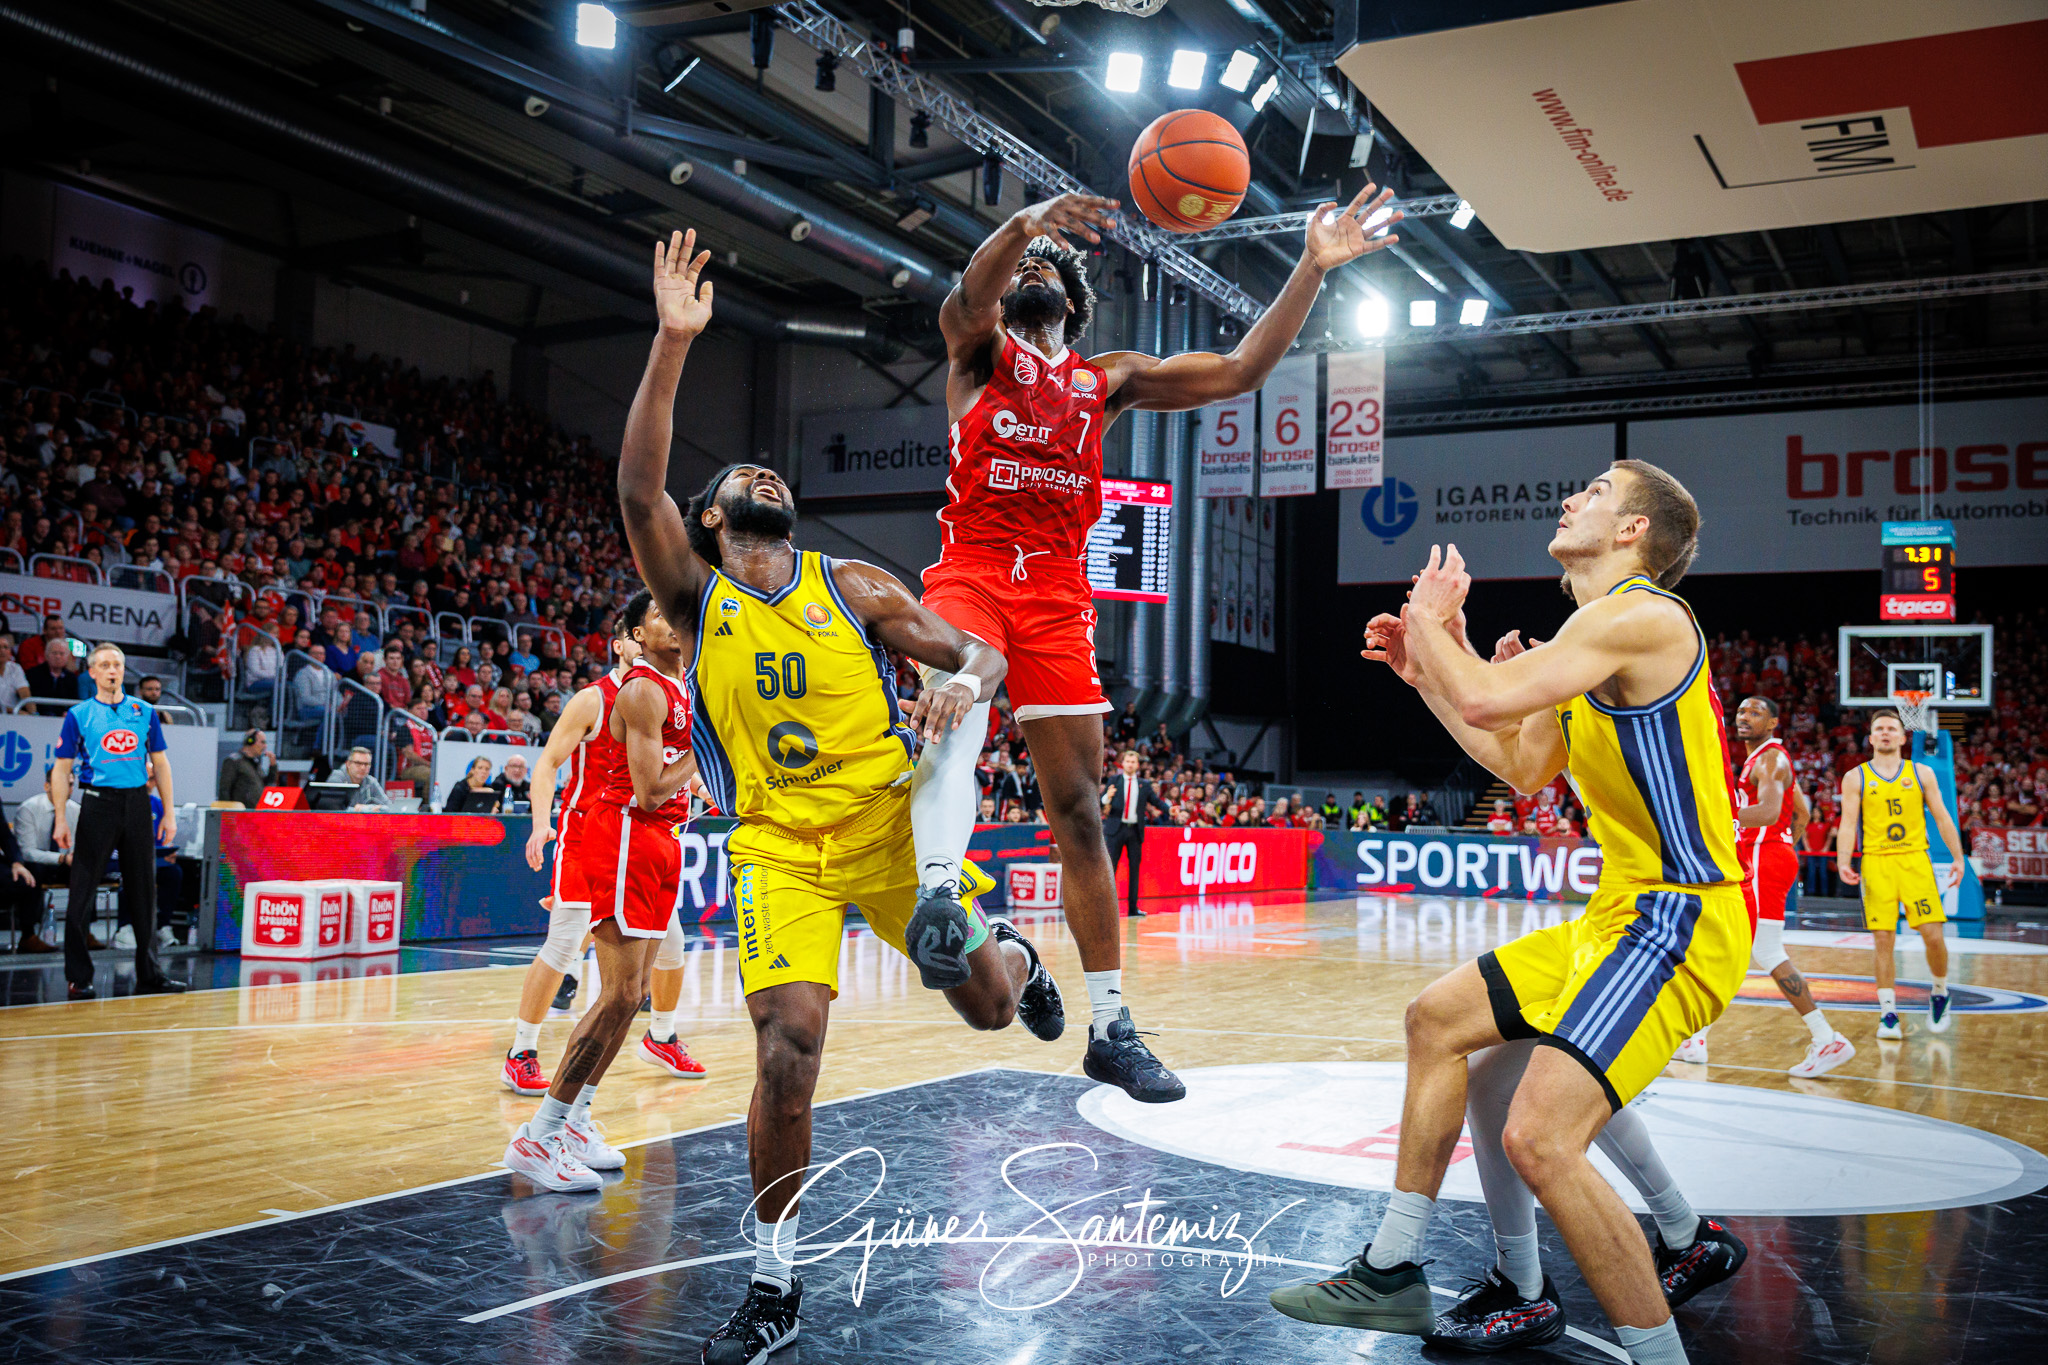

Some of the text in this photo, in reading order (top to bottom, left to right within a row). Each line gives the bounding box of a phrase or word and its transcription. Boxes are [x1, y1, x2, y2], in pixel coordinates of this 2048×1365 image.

[1532, 87, 1634, 202] www.fim-online.de
[1801, 115, 1894, 172] FIM
[1215, 410, 1239, 447] 5
[1276, 408, 1300, 446] 6
[1328, 399, 1381, 438] 23
[1015, 435, 1048, 445] CONSULTING
[1076, 410, 1092, 455] 7
[1201, 451, 1252, 465] brose
[1261, 448, 1314, 463] brose
[1327, 440, 1380, 454] brose
[1201, 463, 1252, 476] baskets
[1261, 462, 1315, 475] bamberg
[1327, 453, 1380, 466] baskets
[1786, 435, 2048, 500] brose
[1151, 486, 1165, 498] 22
[1435, 506, 1563, 525] MOTOREN GM
[1787, 508, 1878, 526] Technik
[1923, 567, 1941, 591] 5
[0, 592, 162, 629] ose ARENA
[1885, 597, 1946, 617] tipico
[755, 652, 807, 700] 50
[766, 760, 843, 790] Schindler
[1886, 799, 1902, 816] 15
[1178, 827, 1257, 896] tipico
[1356, 840, 1602, 894] SPORTWE
[741, 863, 759, 963] interzero
[761, 902, 771, 931] waste
[1914, 899, 1931, 916] 15
[259, 916, 298, 926] SPRUDEL
[764, 934, 774, 954] zero
